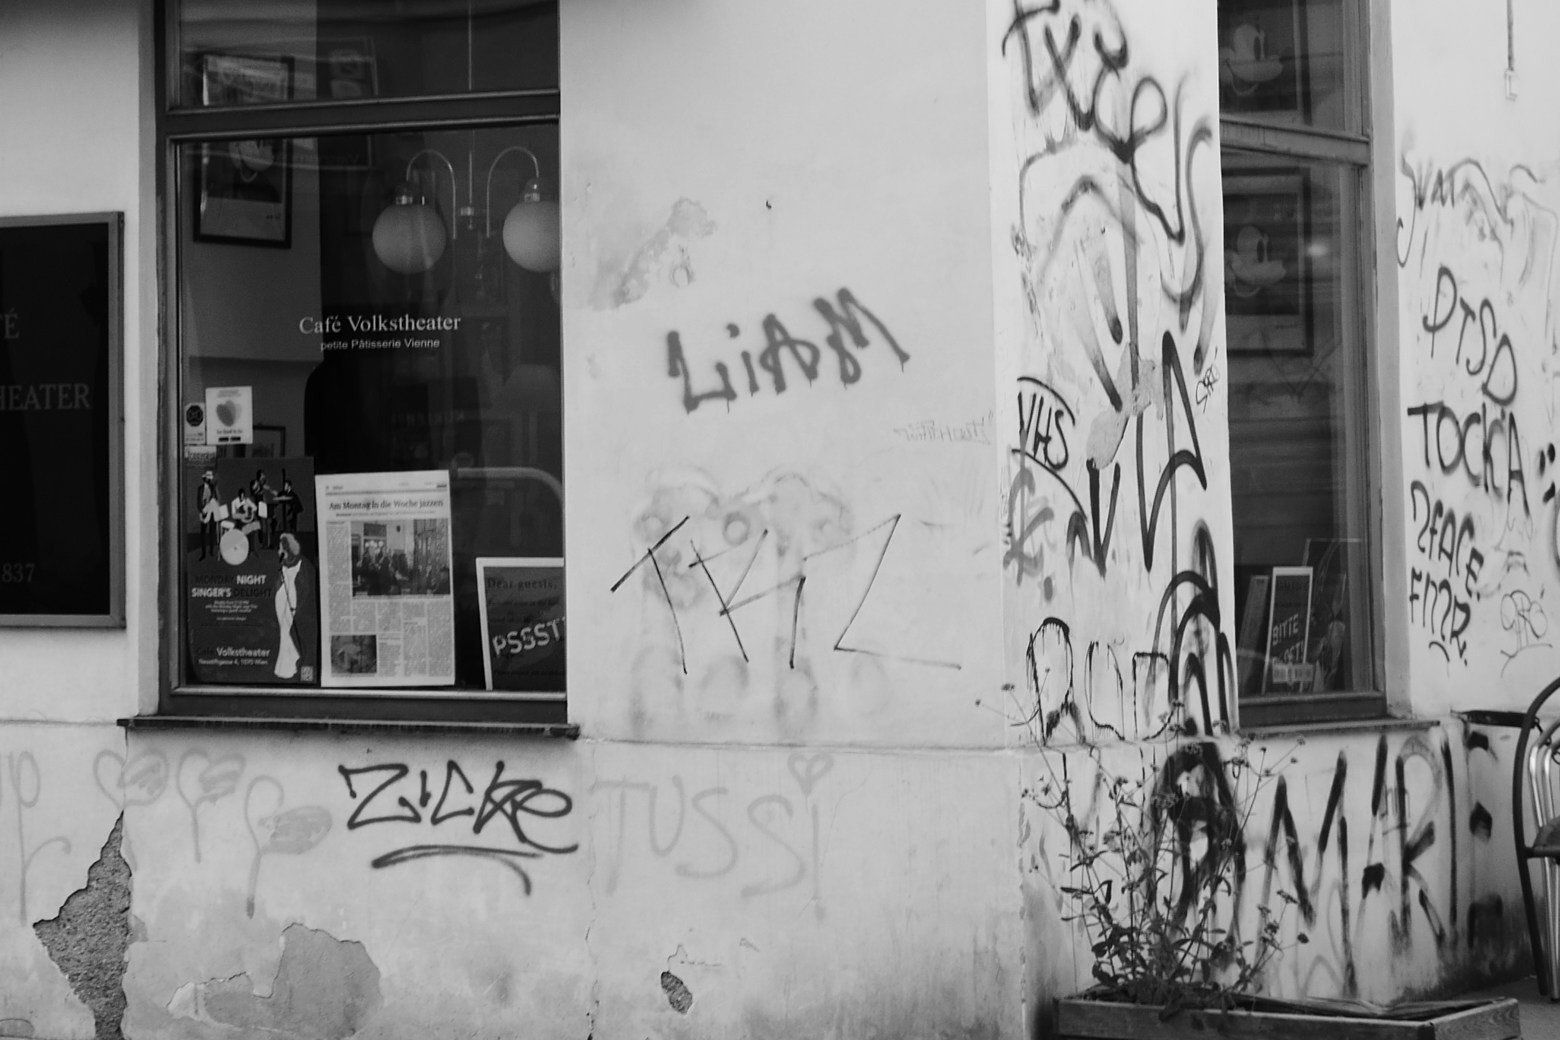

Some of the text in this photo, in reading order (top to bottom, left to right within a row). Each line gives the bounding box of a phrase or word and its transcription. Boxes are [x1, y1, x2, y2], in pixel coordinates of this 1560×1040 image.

[298, 314, 462, 334] Café Volkstheater
[320, 337, 440, 352] petite Pâtisserie Vienne
[236, 574, 267, 585] NIGHT
[1271, 612, 1299, 647] BITTE
[216, 645, 271, 658] Volkstheater
